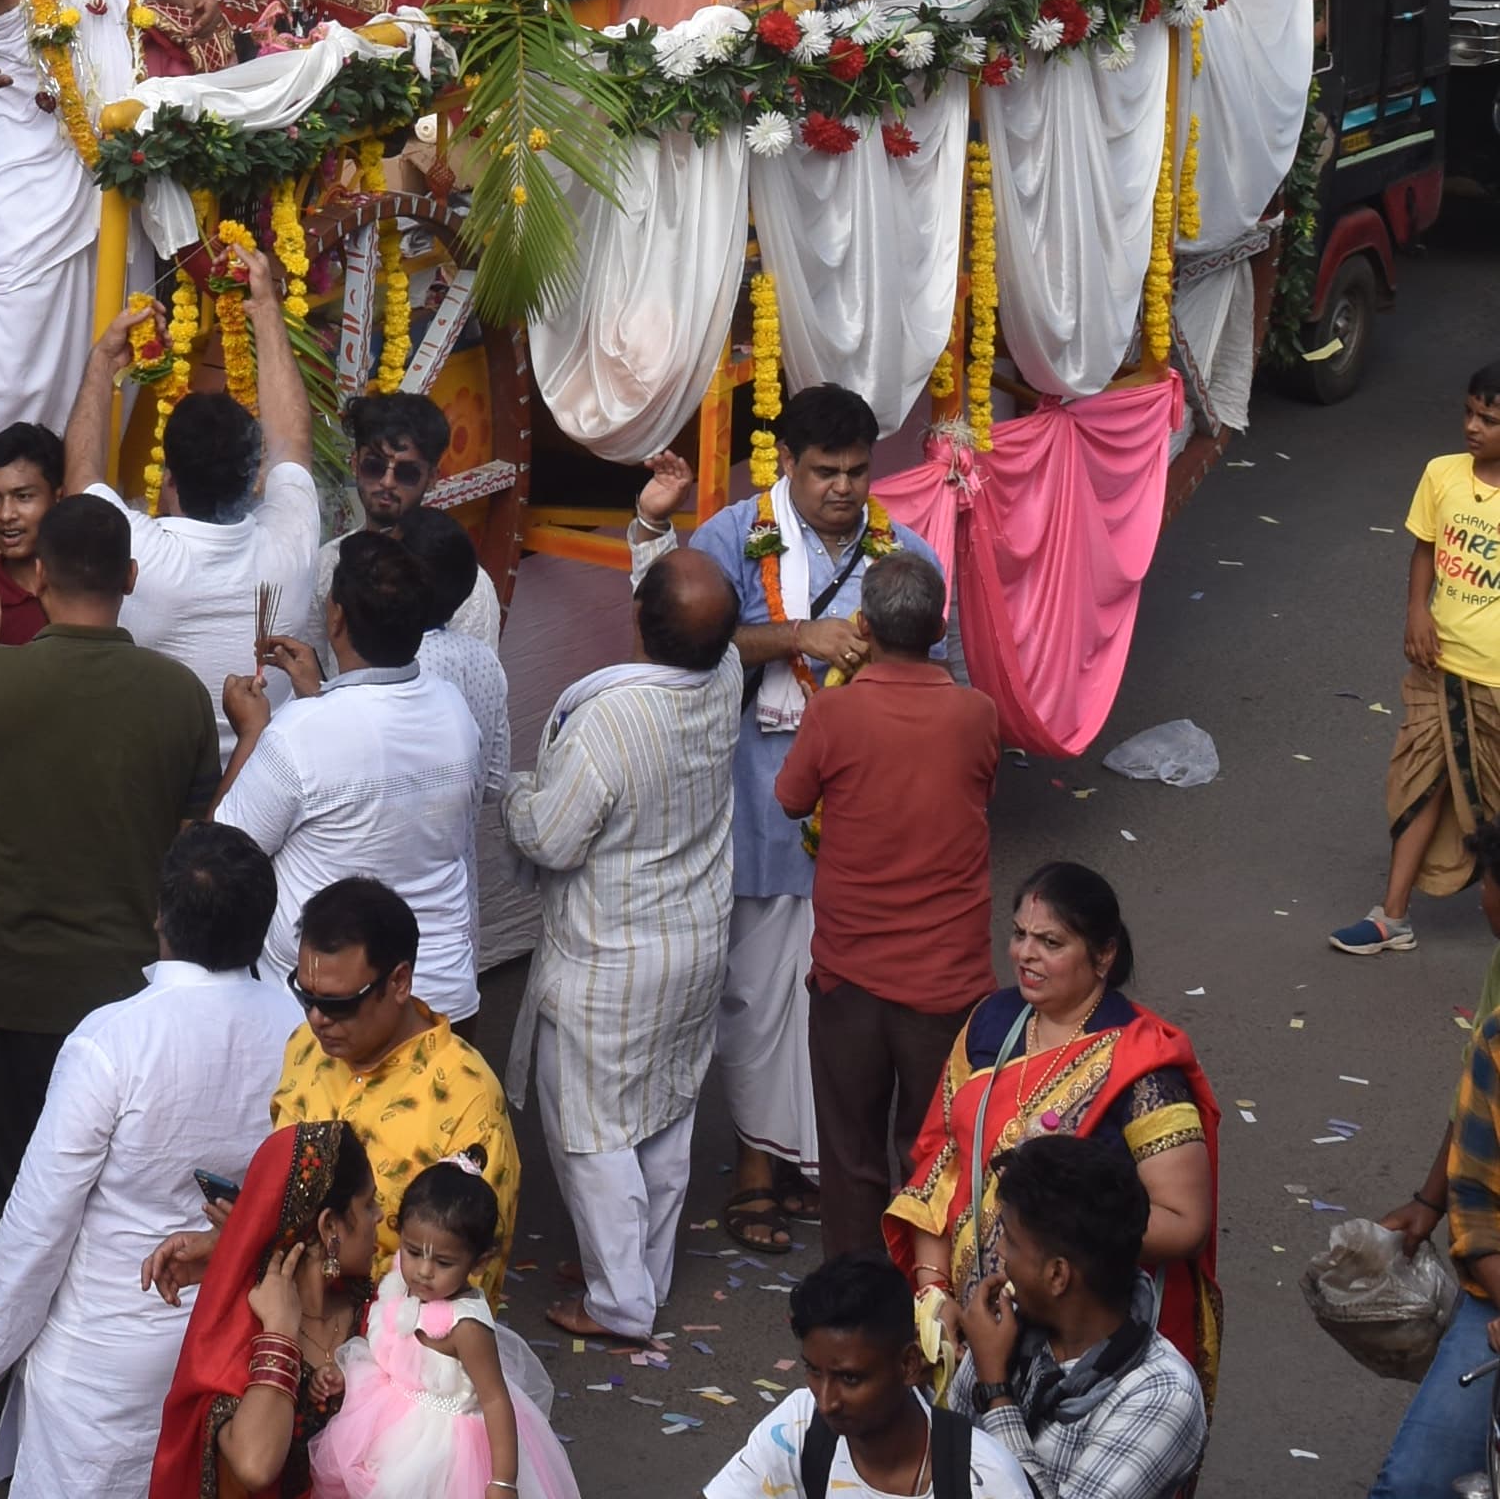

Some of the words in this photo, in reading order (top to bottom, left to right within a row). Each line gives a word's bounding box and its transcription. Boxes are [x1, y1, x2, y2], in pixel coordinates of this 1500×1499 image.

[1453, 513, 1496, 535] CHANT
[1443, 523, 1500, 560] HARE
[1436, 548, 1500, 590] RISHN
[1461, 591, 1498, 605] HAPP
